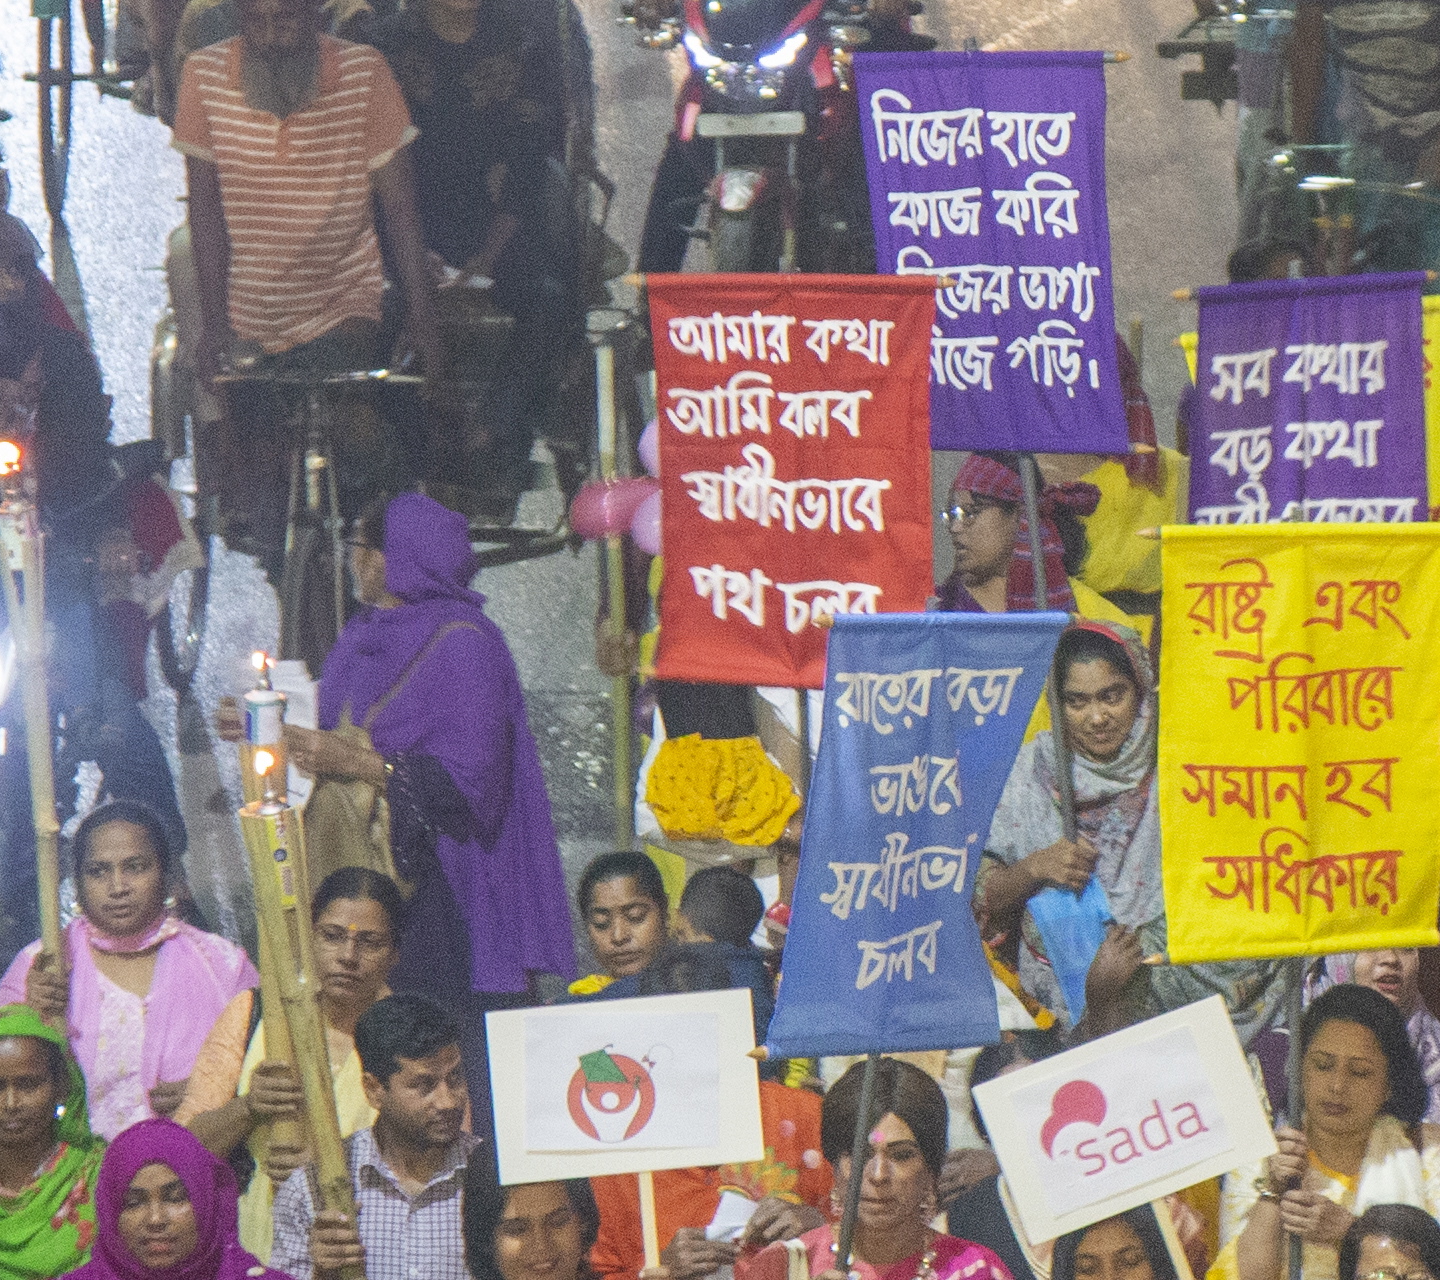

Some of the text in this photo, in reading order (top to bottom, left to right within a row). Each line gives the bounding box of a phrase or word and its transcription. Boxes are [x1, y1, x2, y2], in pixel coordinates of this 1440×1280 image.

[870, 89, 1076, 167] নিজের হাতে
[888, 171, 1080, 239] কাজ করি
[1019, 262, 1100, 322] ভাগ্য
[669, 311, 895, 365] আমার কথা
[666, 371, 873, 439] আমি বলব
[1210, 348, 1277, 405] সব
[1283, 340, 1389, 394] কথার
[1210, 419, 1384, 480] বড় কথা
[681, 443, 892, 533] স্বাধীনভাবে
[689, 563, 772, 627] পথ
[1184, 557, 1411, 664] রাষ্ট্র এবং
[835, 668, 942, 734] রাতের
[1227, 652, 1405, 733] পরিবারে
[1181, 756, 1400, 820] সমান হব
[1202, 826, 1404, 916] অধিকারে
[856, 920, 943, 990] চলব
[1074, 1096, 1209, 1178] sada
